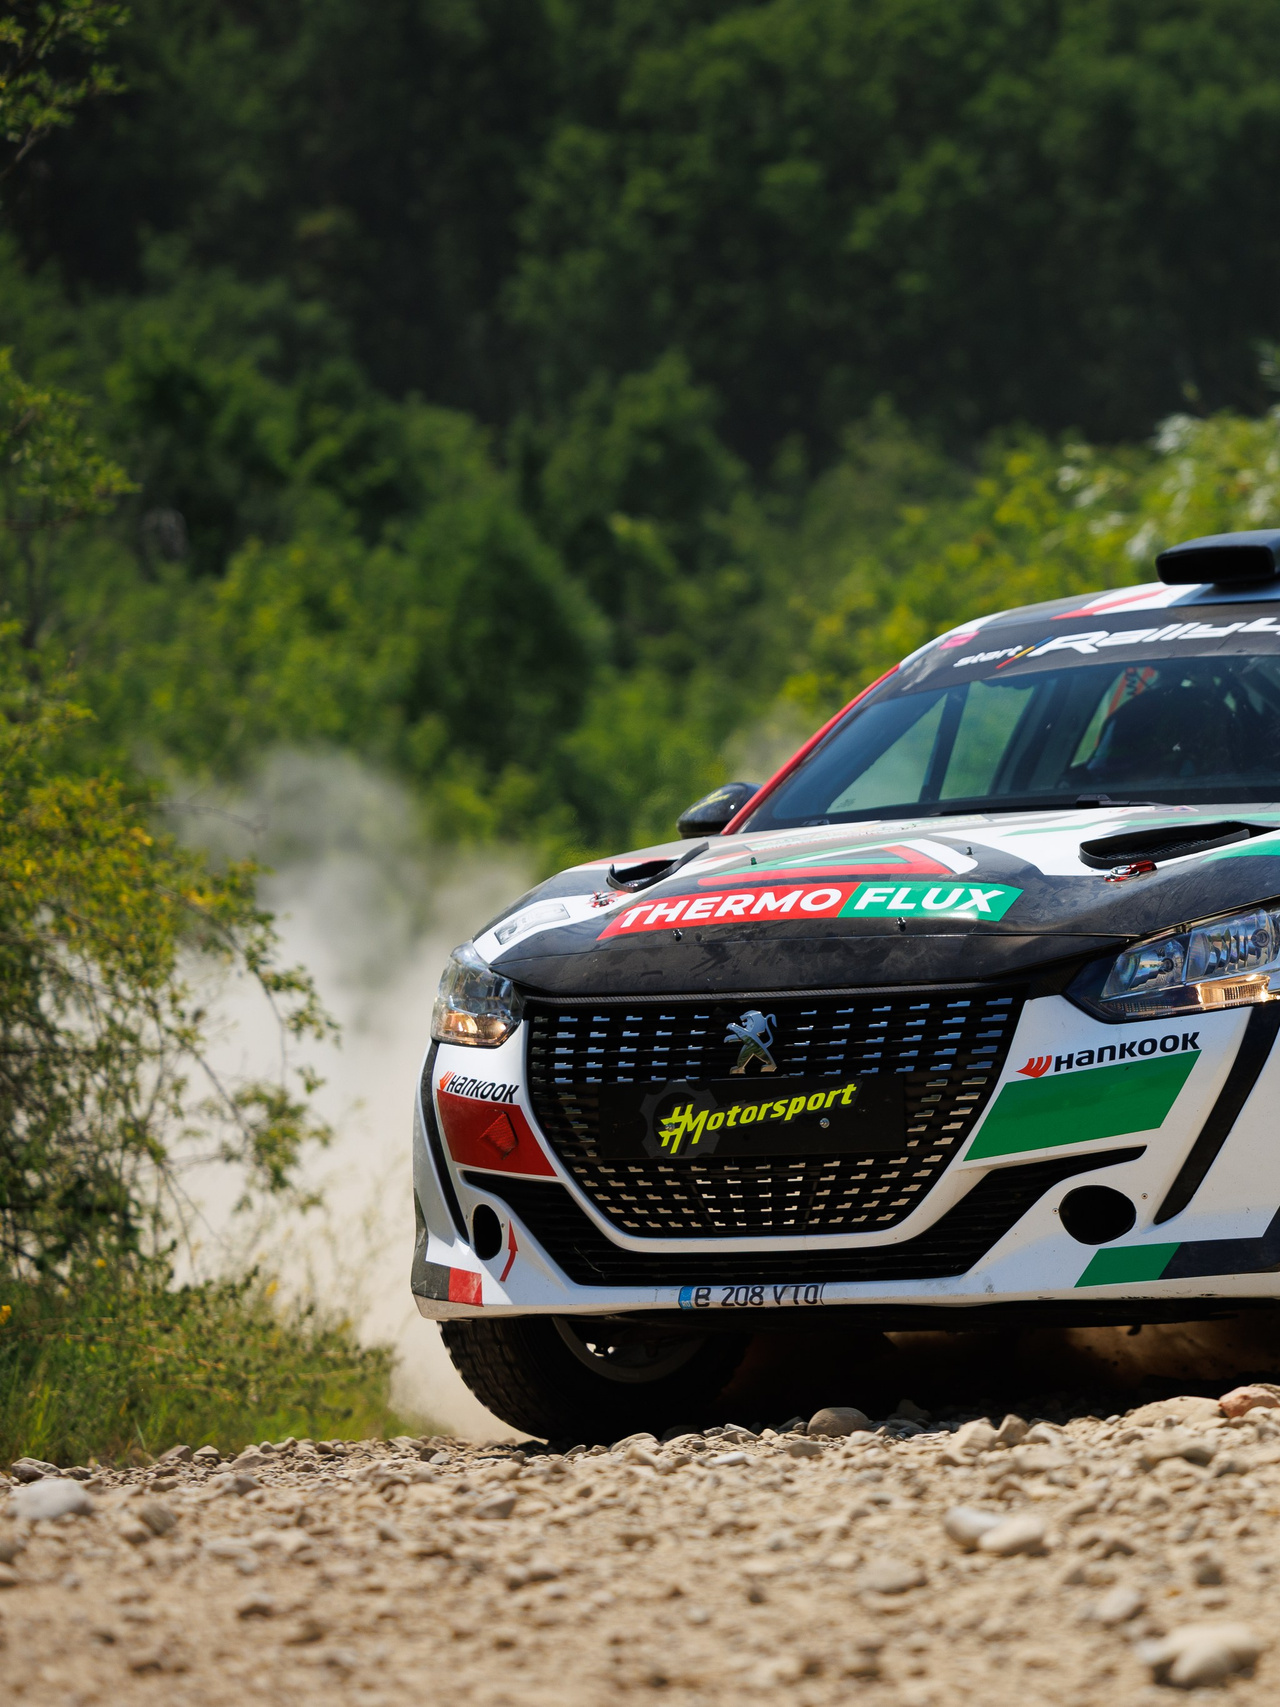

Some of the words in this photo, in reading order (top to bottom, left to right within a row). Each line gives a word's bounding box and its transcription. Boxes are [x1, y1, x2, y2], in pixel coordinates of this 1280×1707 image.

[953, 644, 1023, 668] start
[620, 888, 845, 928] THERMO
[853, 886, 1005, 913] FLUX
[694, 1286, 711, 1307] B
[721, 1285, 765, 1307] 208
